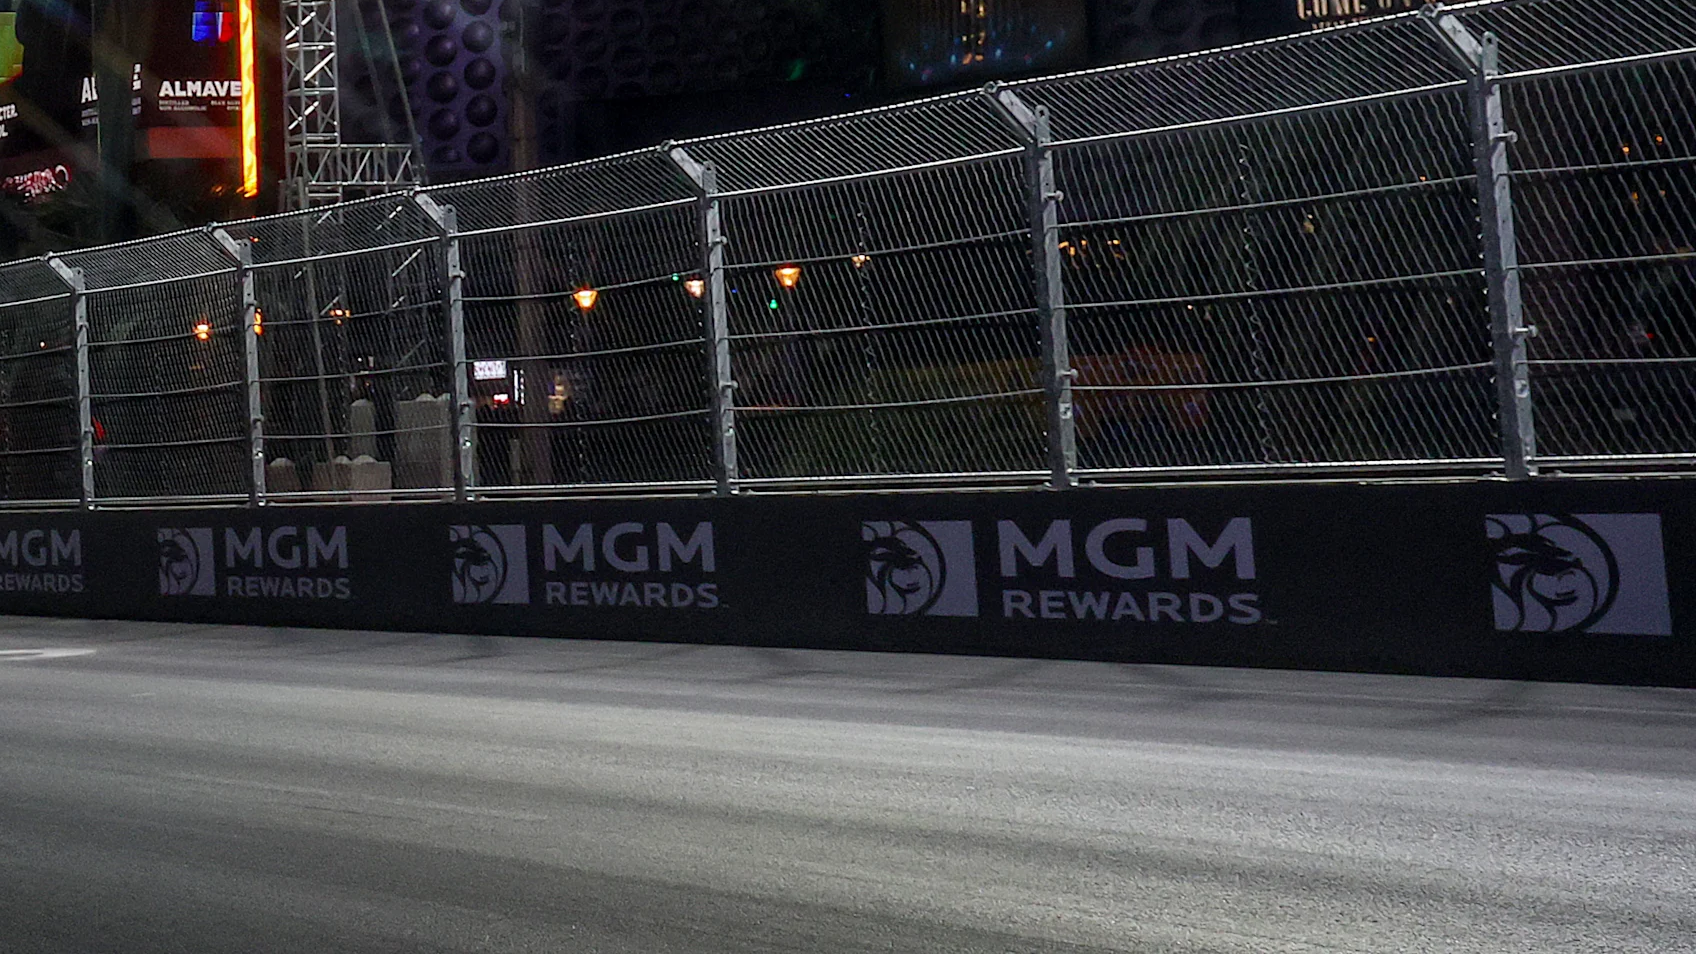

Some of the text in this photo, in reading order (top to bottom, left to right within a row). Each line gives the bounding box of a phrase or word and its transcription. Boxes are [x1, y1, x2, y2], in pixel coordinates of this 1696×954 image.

[225, 526, 349, 569] MGM
[542, 521, 715, 573] MGM
[997, 517, 1256, 580] MGM
[227, 577, 351, 599] REWARDS
[546, 581, 719, 608] REWARDS
[1002, 589, 1262, 625] REWARDS
